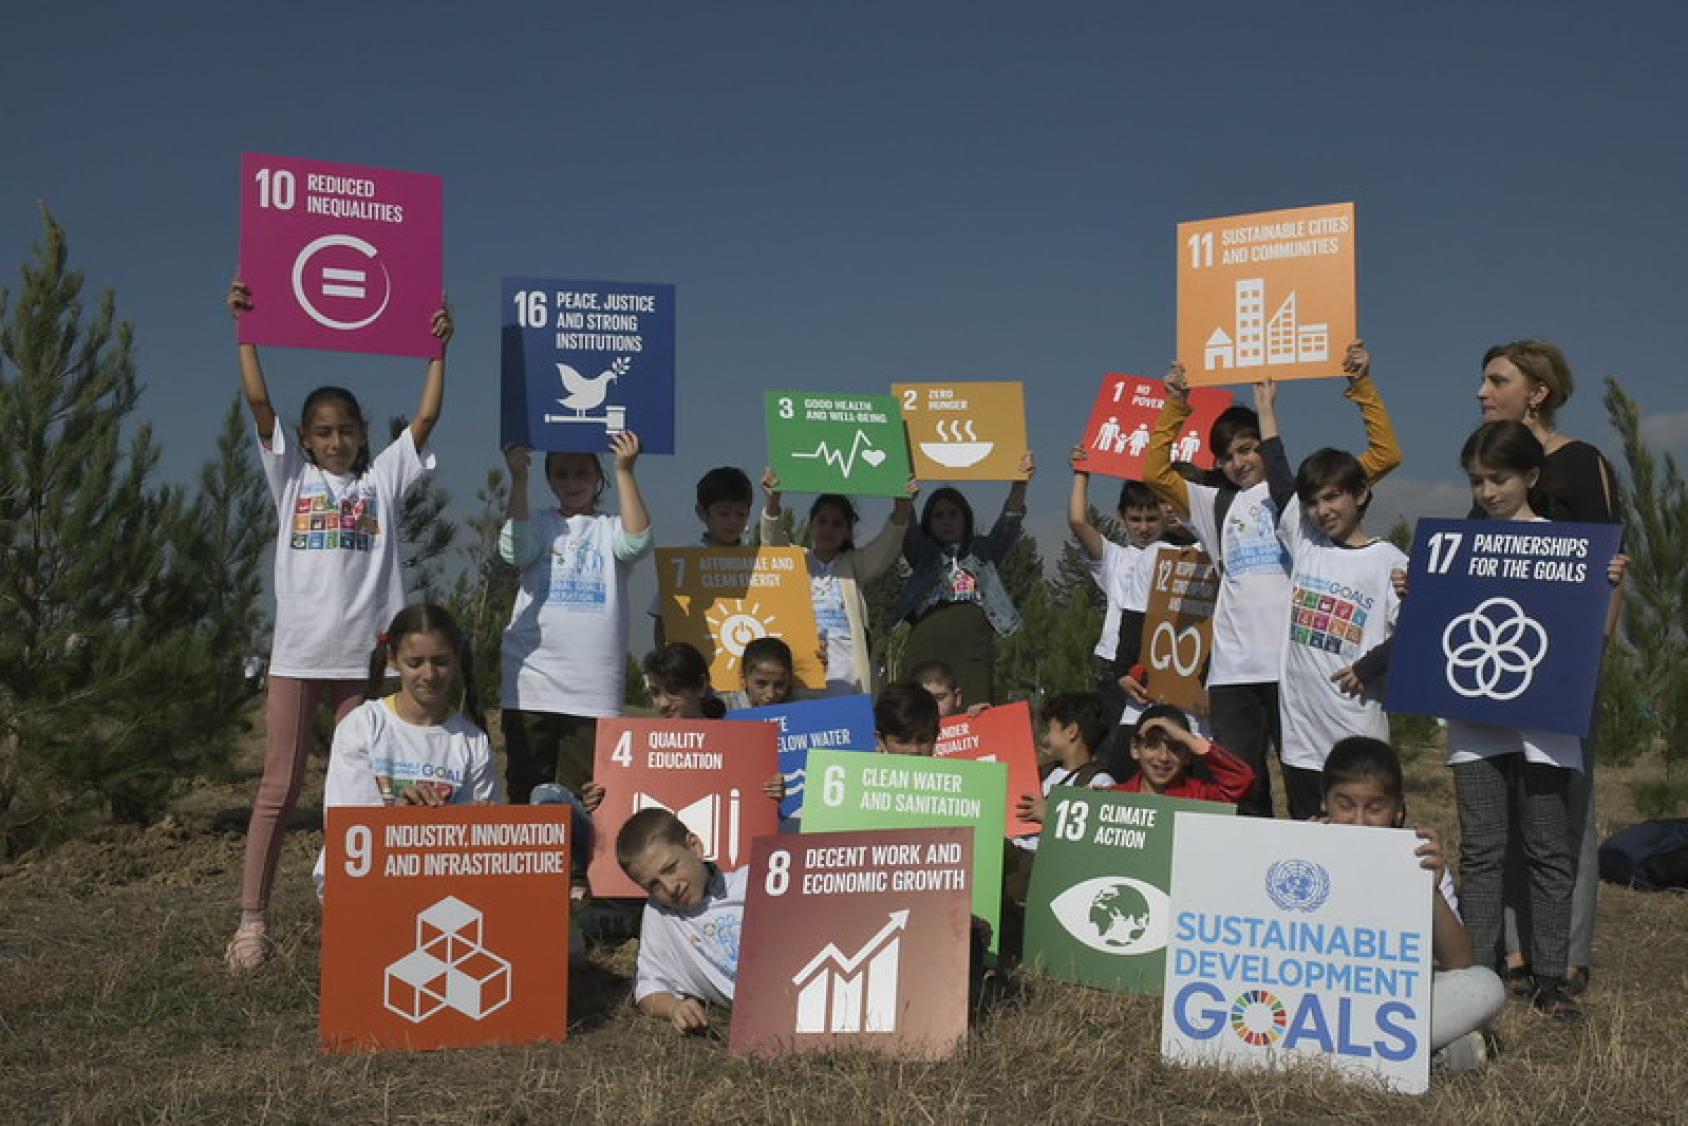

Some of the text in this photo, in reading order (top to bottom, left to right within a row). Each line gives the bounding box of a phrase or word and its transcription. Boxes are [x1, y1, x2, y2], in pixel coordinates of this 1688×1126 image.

[255, 168, 295, 210] 10
[308, 173, 375, 198] REDUCED
[308, 196, 403, 223] INEQUALITIES
[1222, 216, 1349, 245] SUSTAINABLE CITIES
[1188, 232, 1214, 268] 11
[1222, 237, 1339, 264] AND COMMUNITIES
[514, 291, 548, 328] 16
[557, 291, 656, 313] PEACE, JUSTICE
[556, 312, 638, 332] AND STRONG
[556, 333, 643, 352] INSTITUTIONS
[903, 390, 917, 410] 2
[1113, 382, 1125, 402] 1
[1132, 395, 1164, 409] POVER
[779, 397, 795, 419] 3
[1427, 532, 1463, 574] 17
[1473, 534, 1589, 558] PARTNERSHIPS
[671, 558, 686, 588] 7
[1468, 557, 1587, 583] FOR THE GOALS
[611, 730, 633, 768] 4
[649, 732, 705, 749] QUALITY
[777, 728, 852, 753] ELOW WATER
[648, 752, 723, 770] EDUCATION
[824, 765, 846, 807] 6
[861, 768, 962, 793] CLEAN WATER
[860, 791, 981, 818] AND SANITATION
[1099, 804, 1158, 828] CLIMATE
[1055, 800, 1089, 841] 13
[384, 823, 565, 848] INDUSTRY, INNOVATION
[1094, 826, 1146, 850] ACTION
[345, 824, 373, 878] 9
[384, 851, 564, 877] AND INFRASTRUCTURE
[804, 843, 962, 869] DECENT WORK AND
[765, 850, 791, 897] 8
[802, 869, 965, 895] ECONOMIC GROWTH
[1176, 911, 1420, 964] SUSTAINABLE
[1174, 948, 1419, 998] DEVELOPMENT
[1173, 982, 1418, 1062] GOALS
